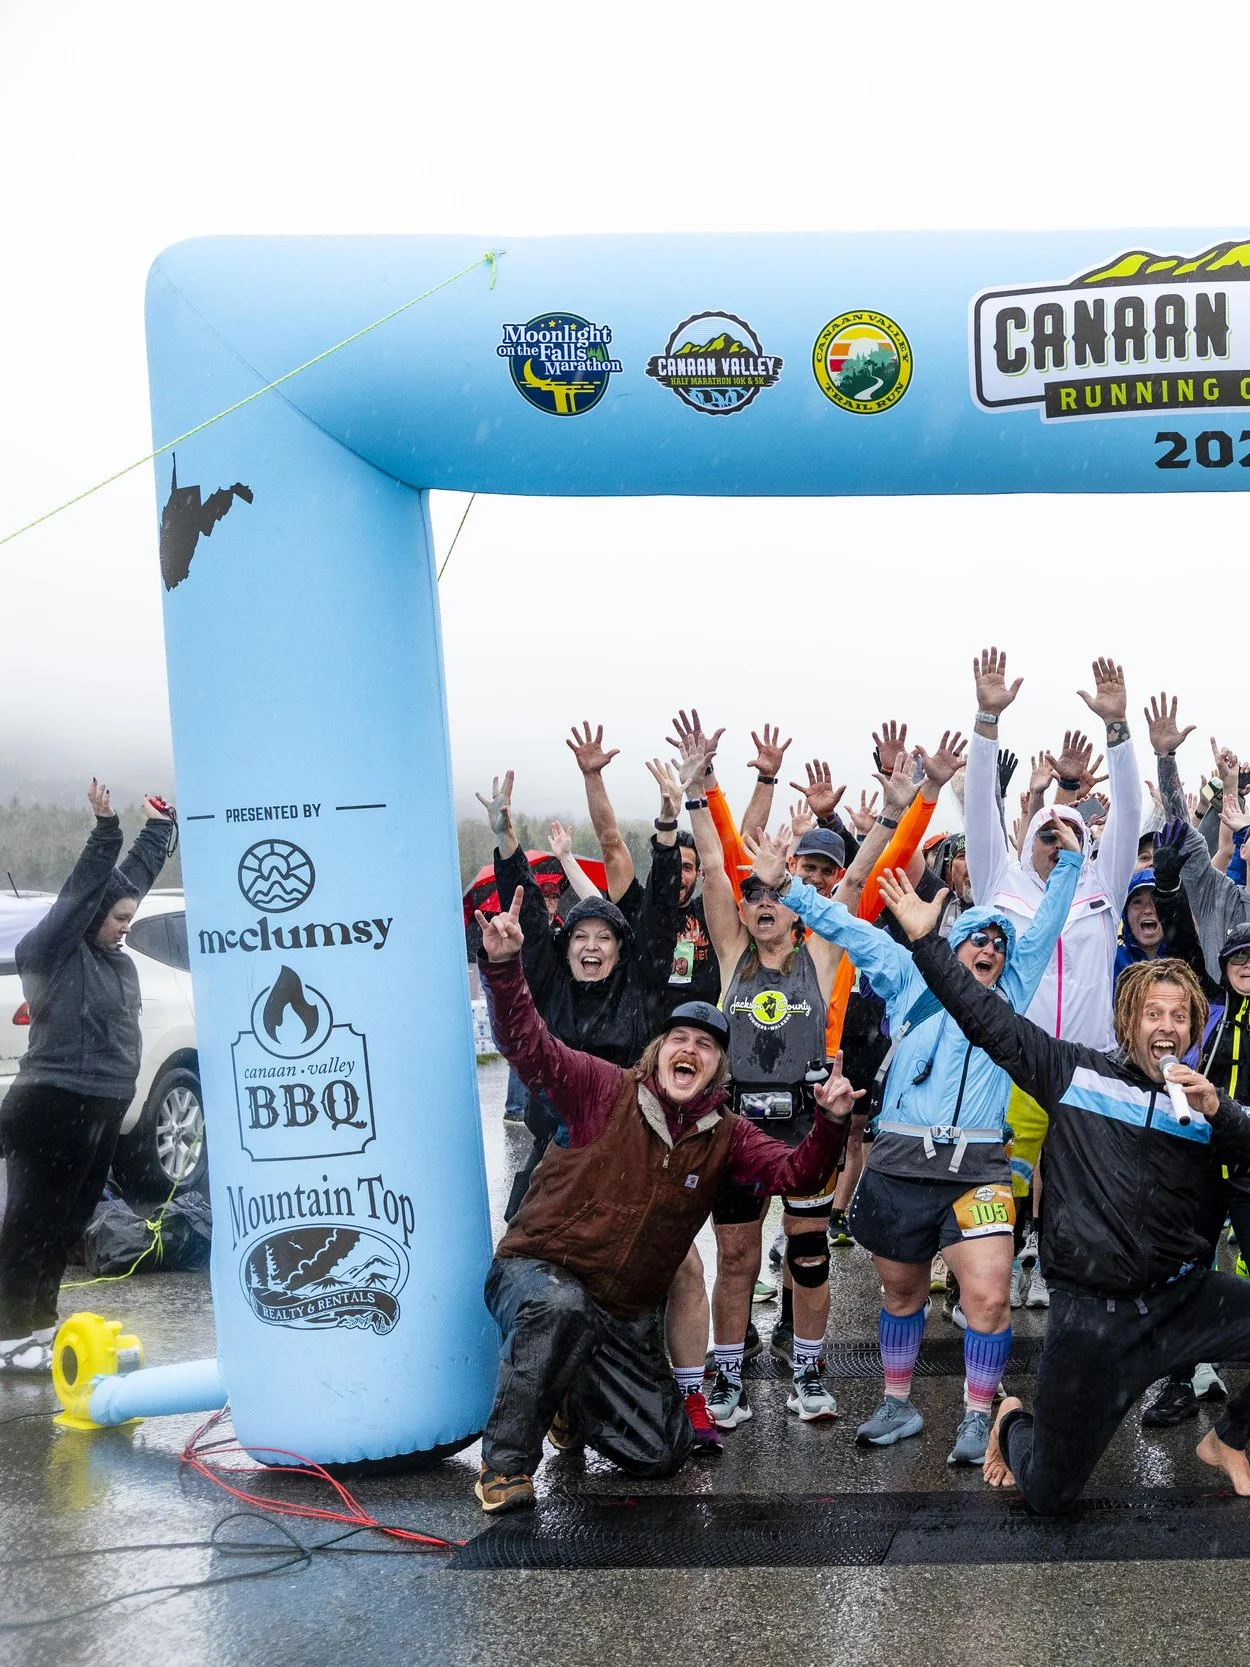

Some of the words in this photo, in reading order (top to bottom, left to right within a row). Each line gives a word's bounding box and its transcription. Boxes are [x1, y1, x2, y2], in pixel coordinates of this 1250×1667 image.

[504, 325, 612, 347] Moonlight
[816, 314, 863, 363] CANAAN
[868, 314, 909, 363] VALLEY
[993, 291, 1230, 376] CANAAN
[498, 347, 515, 356] on
[517, 344, 539, 356] the
[539, 343, 588, 361] Falls
[544, 357, 622, 375] Marathon
[658, 358, 716, 376] CANAAN
[721, 358, 776, 376] VALLEY
[670, 377, 689, 385] HALF
[691, 377, 731, 385] MARATHON
[733, 377, 746, 385] 10K
[747, 377, 753, 385] &
[754, 377, 765, 385] 5K
[825, 382, 873, 410] TRAIL
[875, 382, 904, 409] RUN
[1060, 376, 1219, 411] RUNNING
[225, 804, 299, 823] PRESENTED
[303, 803, 322, 818] BY
[198, 916, 394, 954] mcclumsy
[729, 995, 764, 1015] Jackson
[776, 997, 812, 1017] County
[244, 1064, 297, 1079] canaan
[307, 1056, 356, 1078] valley
[244, 1079, 368, 1131] BBQ
[226, 1174, 355, 1251] Mountain
[357, 1173, 415, 1250] Top
[968, 1202, 1008, 1225] 105
[262, 1307, 304, 1321] REALTY
[307, 1303, 315, 1313] &
[318, 1292, 376, 1311] RENTALS
